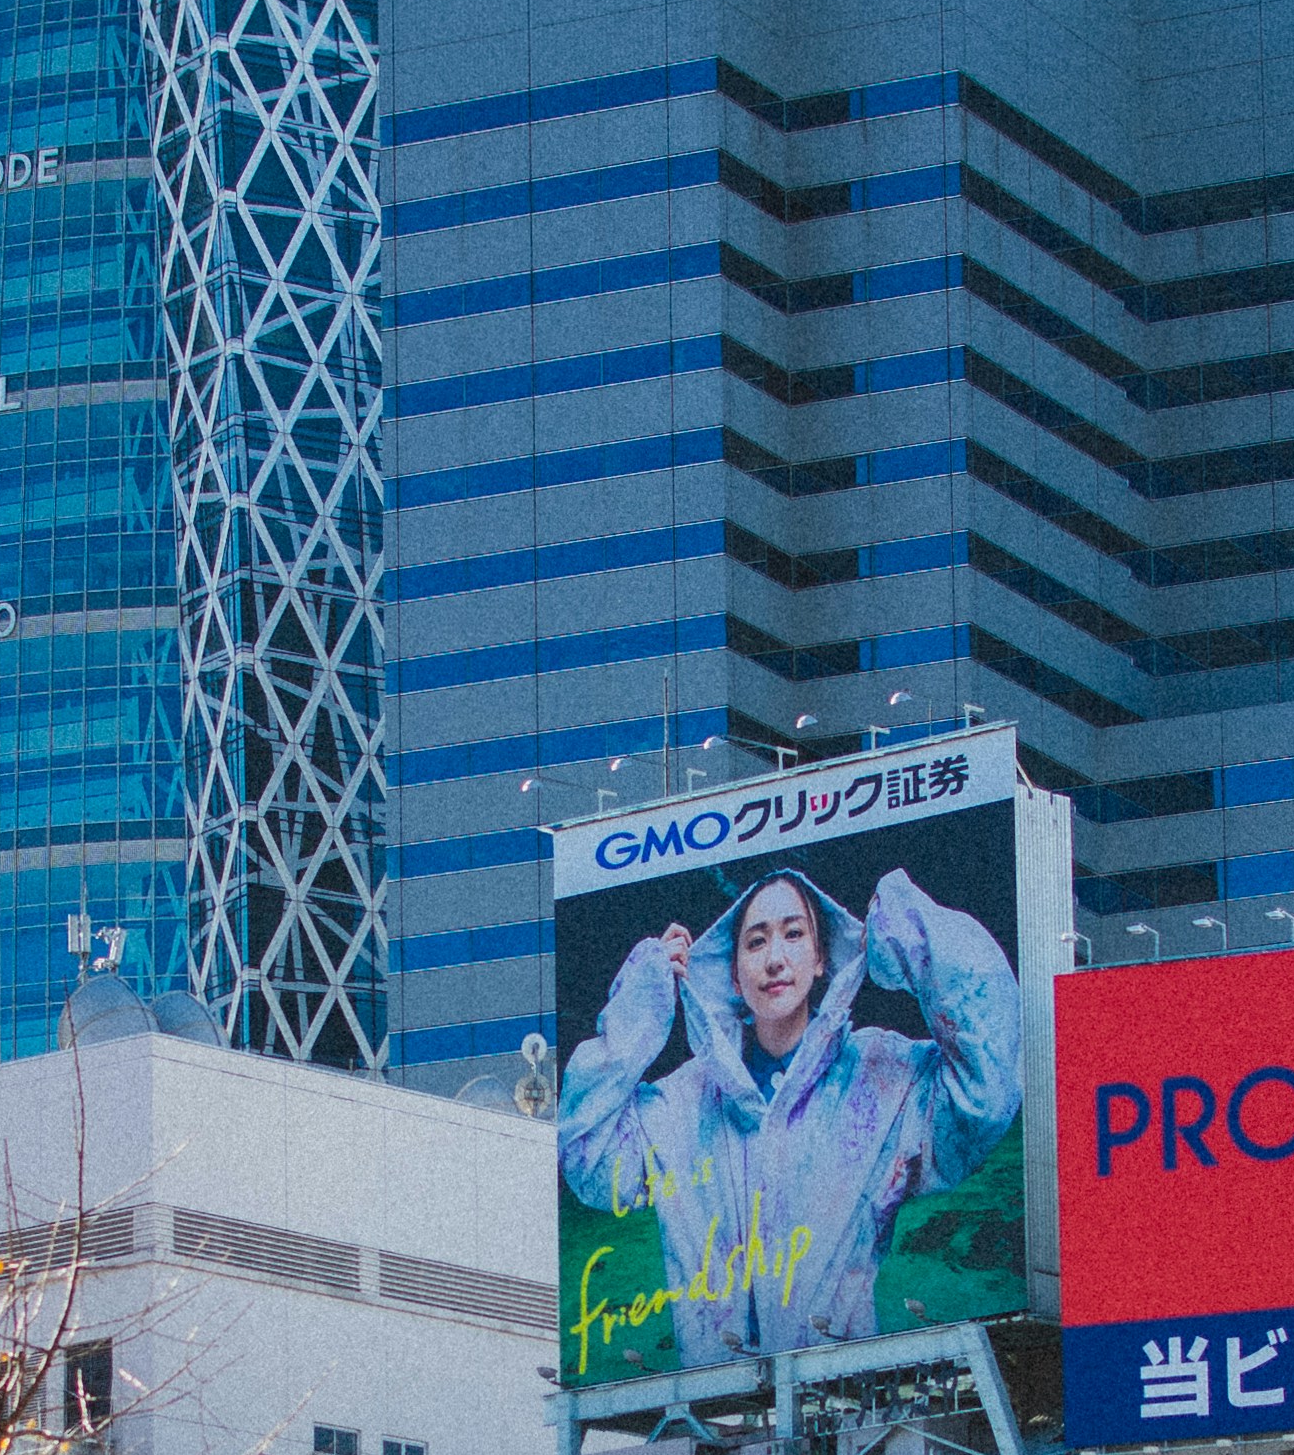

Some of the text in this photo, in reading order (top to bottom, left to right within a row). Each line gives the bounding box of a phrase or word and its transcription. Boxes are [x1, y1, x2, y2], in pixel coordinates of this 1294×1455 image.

[596, 754, 969, 871] GMOクリック証券
[571, 1189, 812, 1375] friendship
